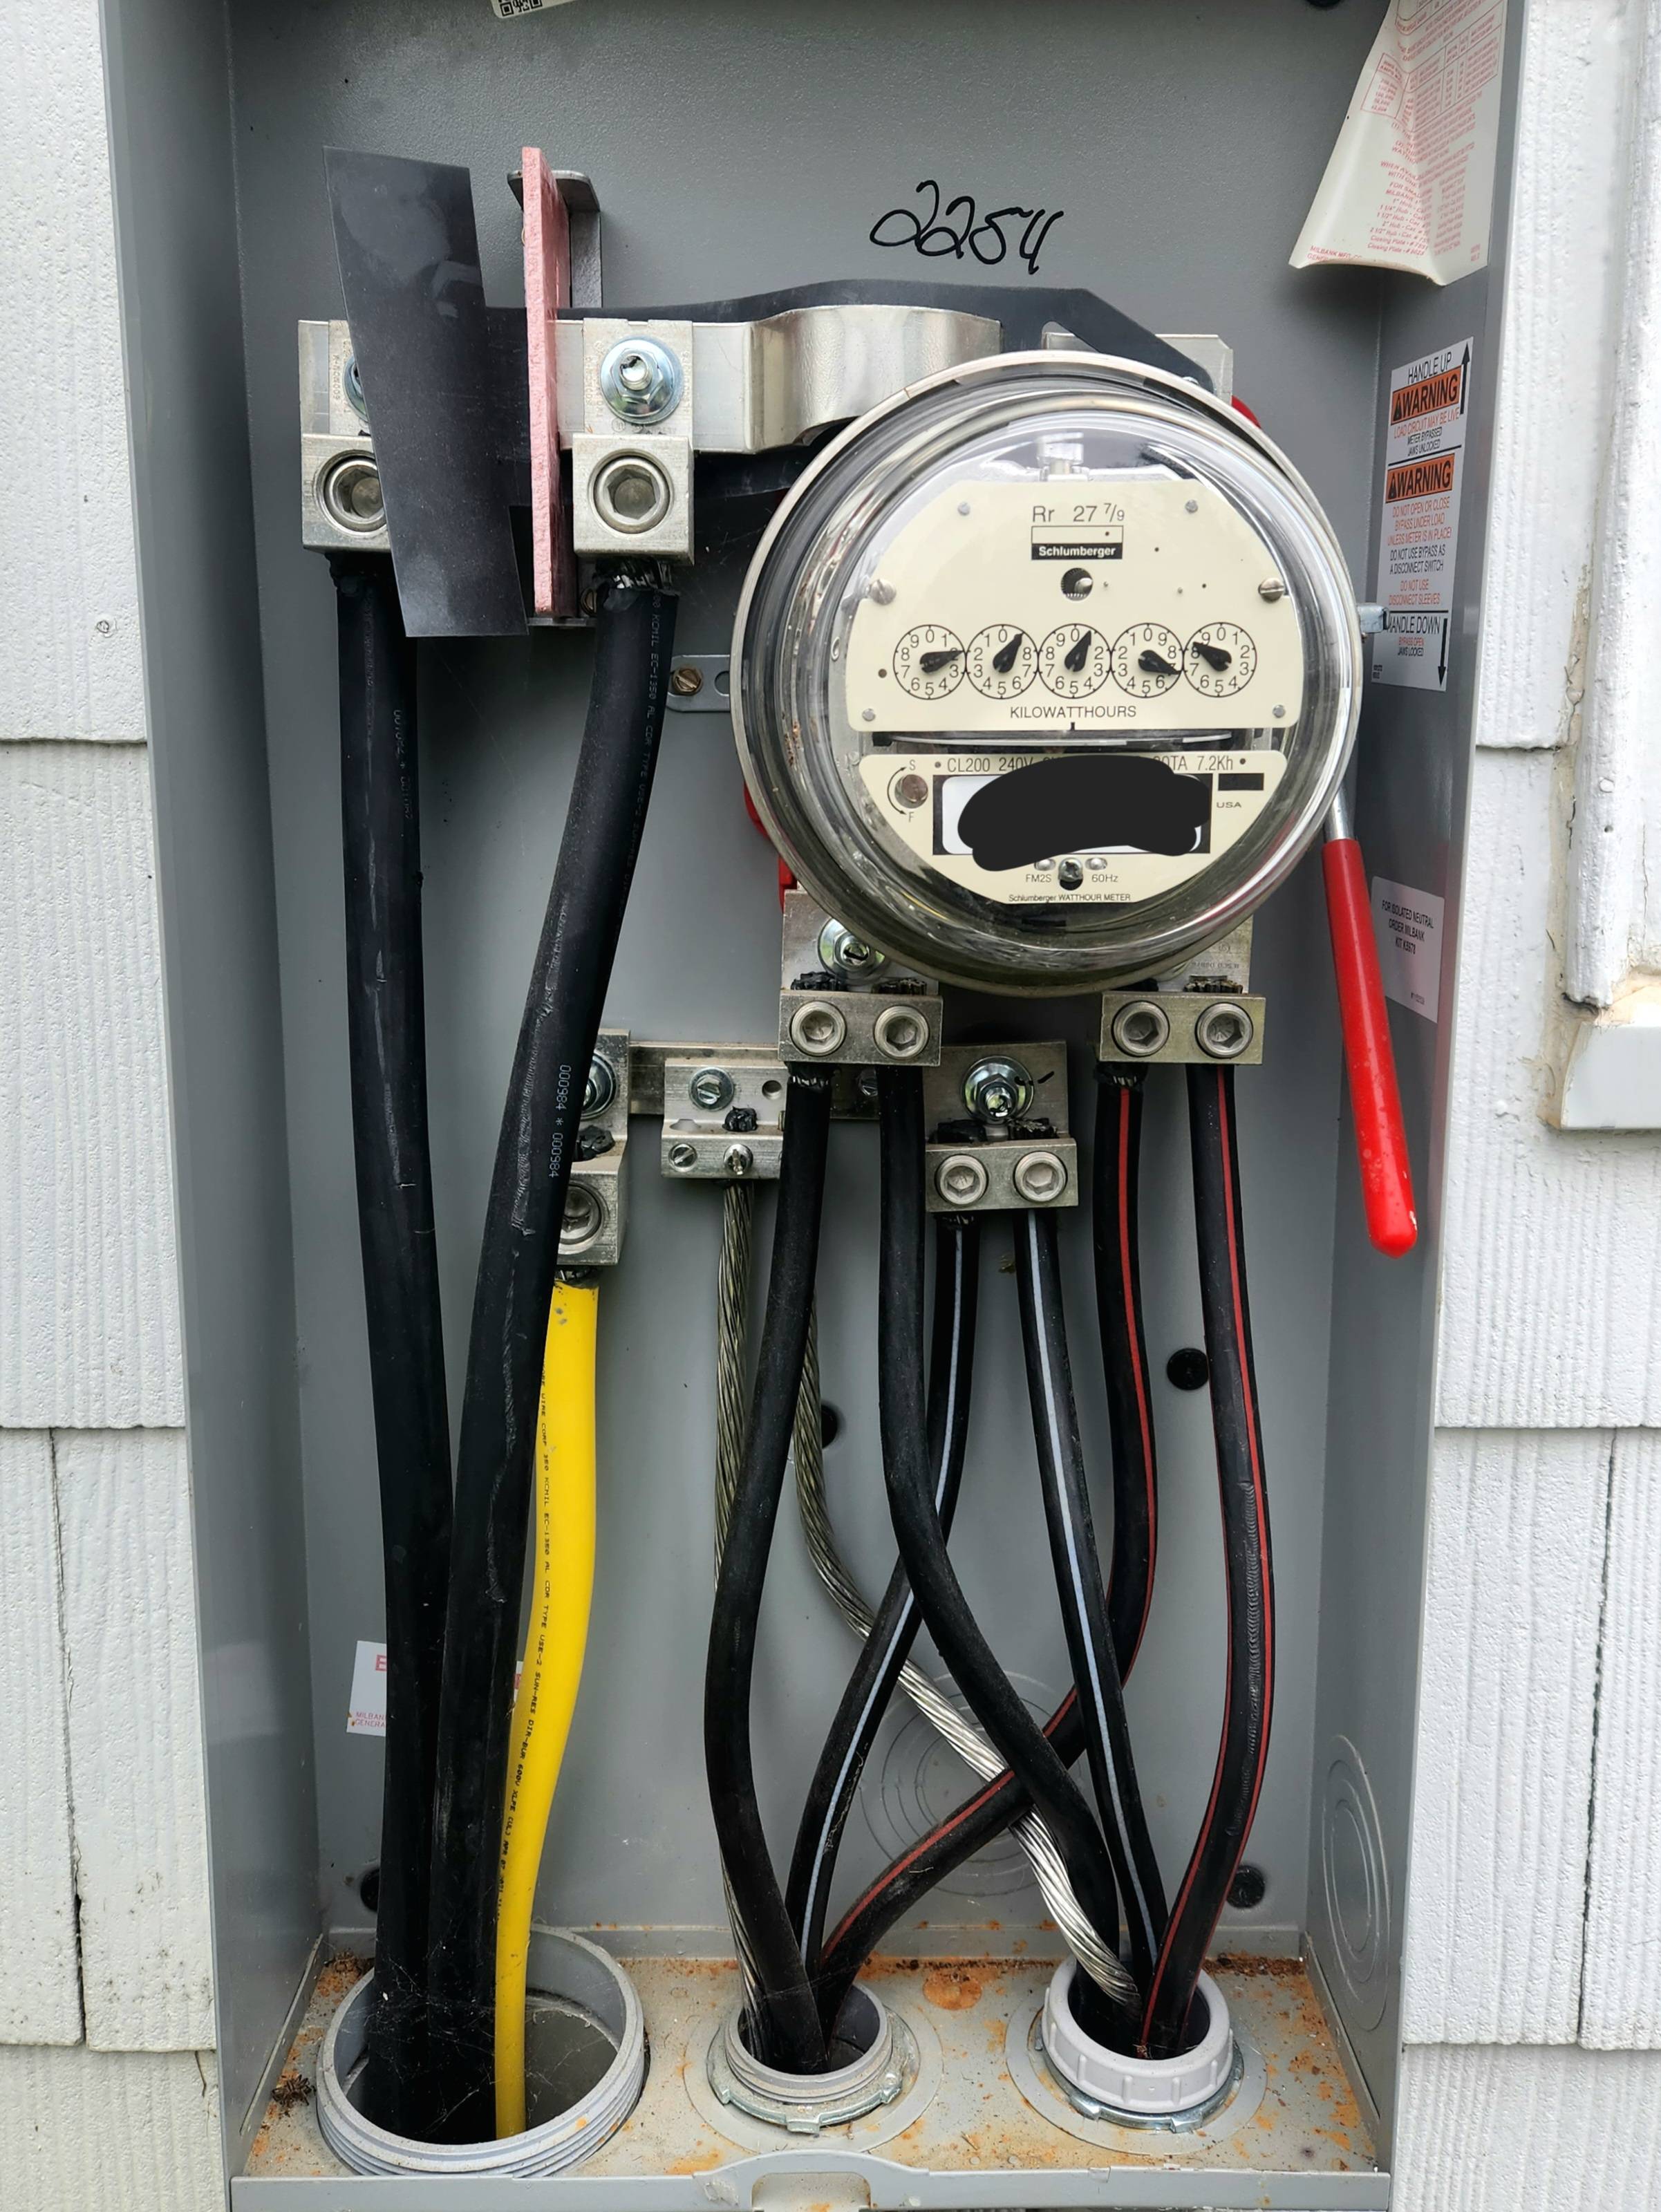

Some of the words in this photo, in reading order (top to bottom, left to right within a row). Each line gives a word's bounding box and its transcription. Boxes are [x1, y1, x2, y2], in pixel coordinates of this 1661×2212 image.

[870, 180, 1065, 274] 2254
[1408, 357, 1438, 384] HANDLE
[1441, 352, 1452, 373] UP
[1402, 373, 1458, 418] WARNING
[1397, 460, 1452, 498] WARNING
[1033, 505, 1055, 523] Rr
[1073, 505, 1098, 523] 27
[1393, 506, 1400, 518] DO
[1400, 503, 1410, 516] NOT
[1411, 500, 1424, 515] OPEN
[1425, 498, 1433, 513] OR
[1433, 496, 1450, 512] CLOSE
[1394, 518, 1413, 531] BYPASS
[1414, 514, 1431, 529] UNDER
[1405, 531, 1422, 544] METER
[1039, 546, 1116, 558] Schlumberger
[1390, 550, 1398, 561] DO
[1398, 547, 1408, 561] NOT
[1408, 547, 1418, 559] USE
[1418, 544, 1438, 559] BYPASS
[1438, 543, 1446, 556] AS
[1394, 561, 1424, 574] DISCONNECT
[1425, 559, 1444, 573] SWITCH
[1400, 581, 1408, 591] DO
[1408, 580, 1418, 591] NOT
[1419, 579, 1429, 590] USE
[1389, 594, 1418, 606] DISCONNECT
[1418, 592, 1441, 606] SLEEVES
[651, 614, 660, 647] KCMIL
[1416, 616, 1441, 635] DOWN
[910, 634, 919, 648] 9
[926, 629, 935, 643] 0
[941, 633, 946, 647] 1
[984, 633, 990, 647] 1
[998, 628, 1007, 643] 0
[1056, 633, 1065, 646] 9
[1071, 628, 1080, 641] 0
[1130, 632, 1135, 646] 1
[1143, 628, 1152, 641] 0
[1158, 632, 1167, 646] 9
[1201, 632, 1210, 645] 9
[1217, 627, 1226, 641] 0
[1232, 632, 1237, 645] 1
[901, 648, 910, 661] 8
[974, 648, 983, 660] 2
[1022, 647, 1031, 660] 8
[1046, 646, 1054, 660] 8
[1094, 646, 1104, 659] 2
[1118, 646, 1127, 659] 2
[1167, 646, 1176, 659] 8
[1191, 646, 1200, 659] 8
[1240, 645, 1250, 658] 2
[901, 665, 910, 678] 7
[949, 664, 959, 678] 3
[974, 664, 983, 678] 3
[1022, 664, 1031, 677] 7
[1045, 664, 1054, 677] 7
[1094, 663, 1103, 677] 3
[1118, 663, 1127, 677] 3
[1190, 663, 1199, 676] 7
[1239, 662, 1249, 675] 3
[911, 677, 920, 691] 6
[939, 677, 948, 691] 4
[983, 677, 991, 690] 4
[997, 682, 1006, 695] 5
[1012, 676, 1021, 690] 6
[1055, 676, 1064, 690] 6
[1069, 681, 1078, 694] 5
[1084, 677, 1093, 690] 4
[1127, 676, 1136, 689] 4
[1142, 680, 1150, 693] 5
[1156, 675, 1165, 688] 6
[1200, 675, 1209, 688] 6
[1214, 679, 1223, 693] 5
[1228, 675, 1237, 688] 4
[925, 682, 934, 696] 5
[1010, 705, 1136, 719] KILOWATTHOURS
[909, 759, 916, 771] S
[947, 758, 991, 773] CL200
[1197, 756, 1233, 771] 7.2Kh
[908, 812, 914, 823] F
[1025, 874, 1052, 883] FM2S
[1091, 874, 1118, 883] 60Hz
[1008, 894, 1056, 903] Schlumberger
[1382, 899, 1391, 912] FOR
[1391, 903, 1412, 921] ISOLATED
[1413, 910, 1434, 929] NEUTRAL
[1389, 918, 1404, 934] ORDER
[1405, 924, 1425, 941] MILBANK
[556, 1065, 571, 1111] 000984
[549, 1132, 563, 1179] 000984
[545, 1561, 550, 1573] AL
[536, 1634, 545, 1666] USE-2
[530, 1671, 541, 1715] SUN-RES
[355, 1718, 386, 1727] GENERA
[356, 1711, 386, 1721] MILBAN
[520, 1719, 534, 1760] DIR-BUR
[509, 1790, 518, 1812] XLPE
